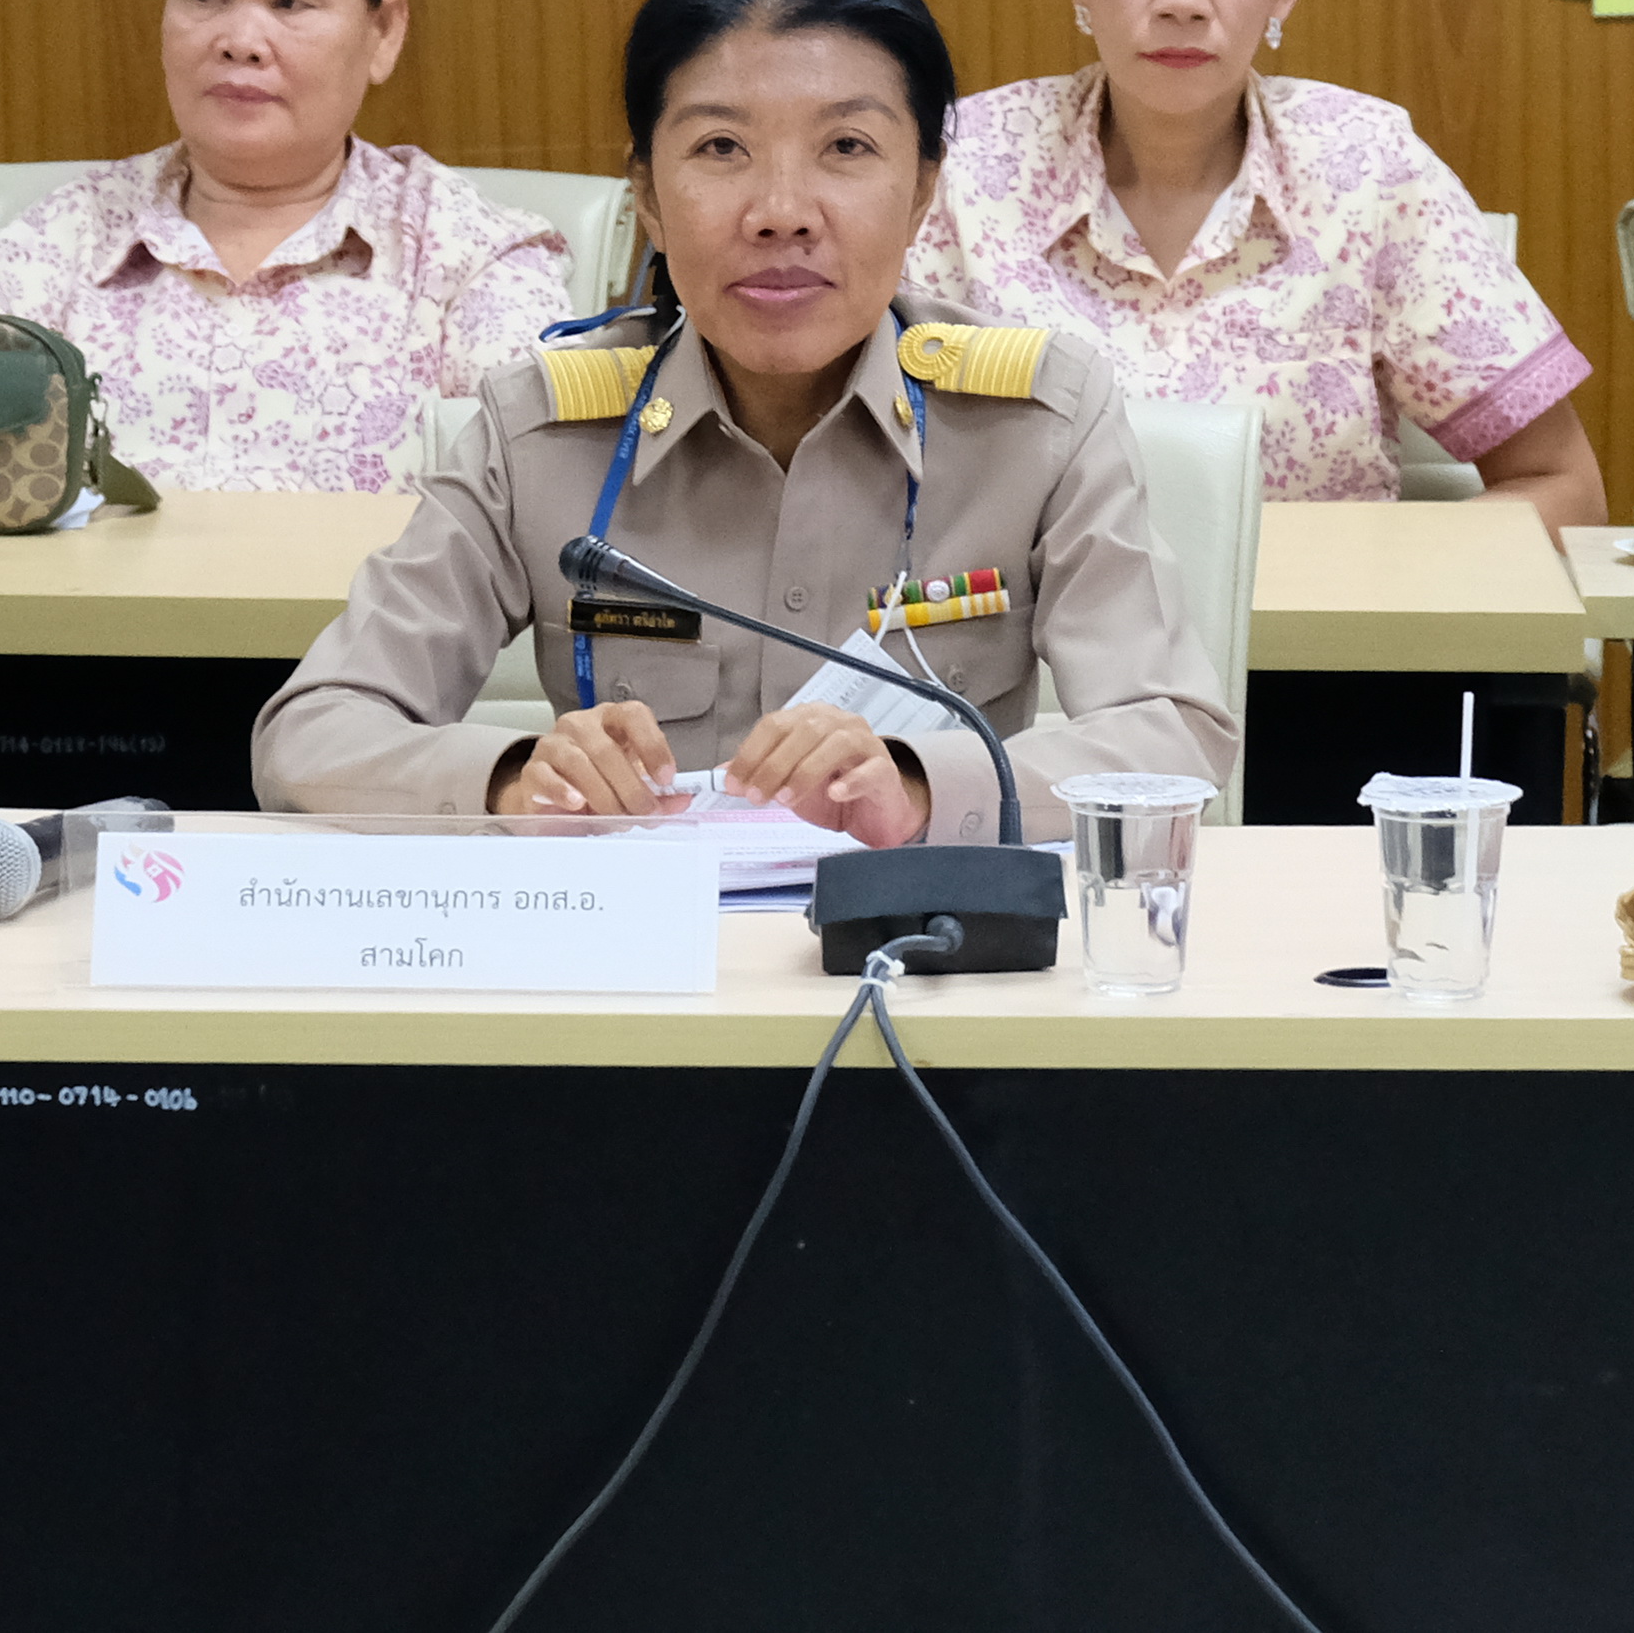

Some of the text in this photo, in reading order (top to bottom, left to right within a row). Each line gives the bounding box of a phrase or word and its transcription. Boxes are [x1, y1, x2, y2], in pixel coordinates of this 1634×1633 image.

[238, 878, 605, 918] สำนักงานเลขานุการ อกส.อ.
[360, 938, 465, 969] สามโคก
